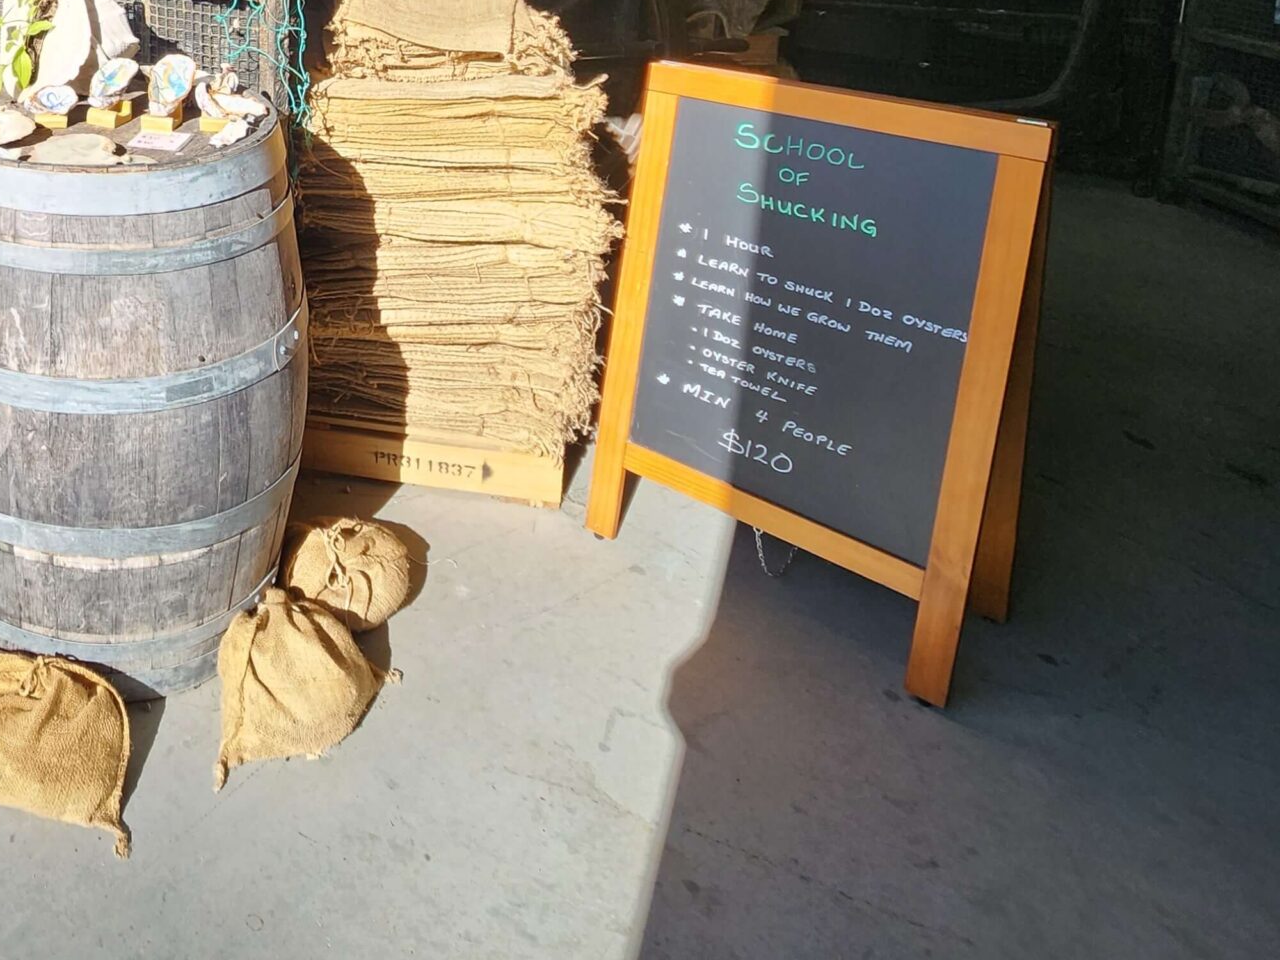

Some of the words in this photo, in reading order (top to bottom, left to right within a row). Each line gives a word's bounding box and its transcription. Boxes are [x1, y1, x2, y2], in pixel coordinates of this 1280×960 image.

[734, 123, 865, 169] SCHOOL
[779, 167, 810, 186] OF
[736, 182, 877, 237] SHUCKING
[725, 234, 774, 258] HOUR
[691, 277, 736, 297] LEARN
[744, 292, 771, 307] HOW
[778, 303, 802, 317] WE
[806, 312, 851, 333] GROW
[865, 330, 913, 353] THEM
[698, 254, 749, 277] LEARN
[757, 272, 778, 285] TO
[784, 280, 834, 303] SHUCK
[858, 301, 893, 320] DOZ
[902, 314, 968, 343] OYSTERS
[697, 304, 742, 325] TAKE
[754, 322, 799, 344] HOME
[702, 348, 755, 373] OYSTER
[766, 371, 818, 396] KNIFE
[713, 330, 742, 349] DOZ
[752, 345, 817, 373] OYSTERS
[699, 363, 726, 379] TEA
[731, 375, 787, 403] TOWEL
[682, 383, 731, 409] MIN
[755, 409, 769, 423] 4
[782, 420, 853, 456] PEOPLE
[718, 428, 793, 473] $120
